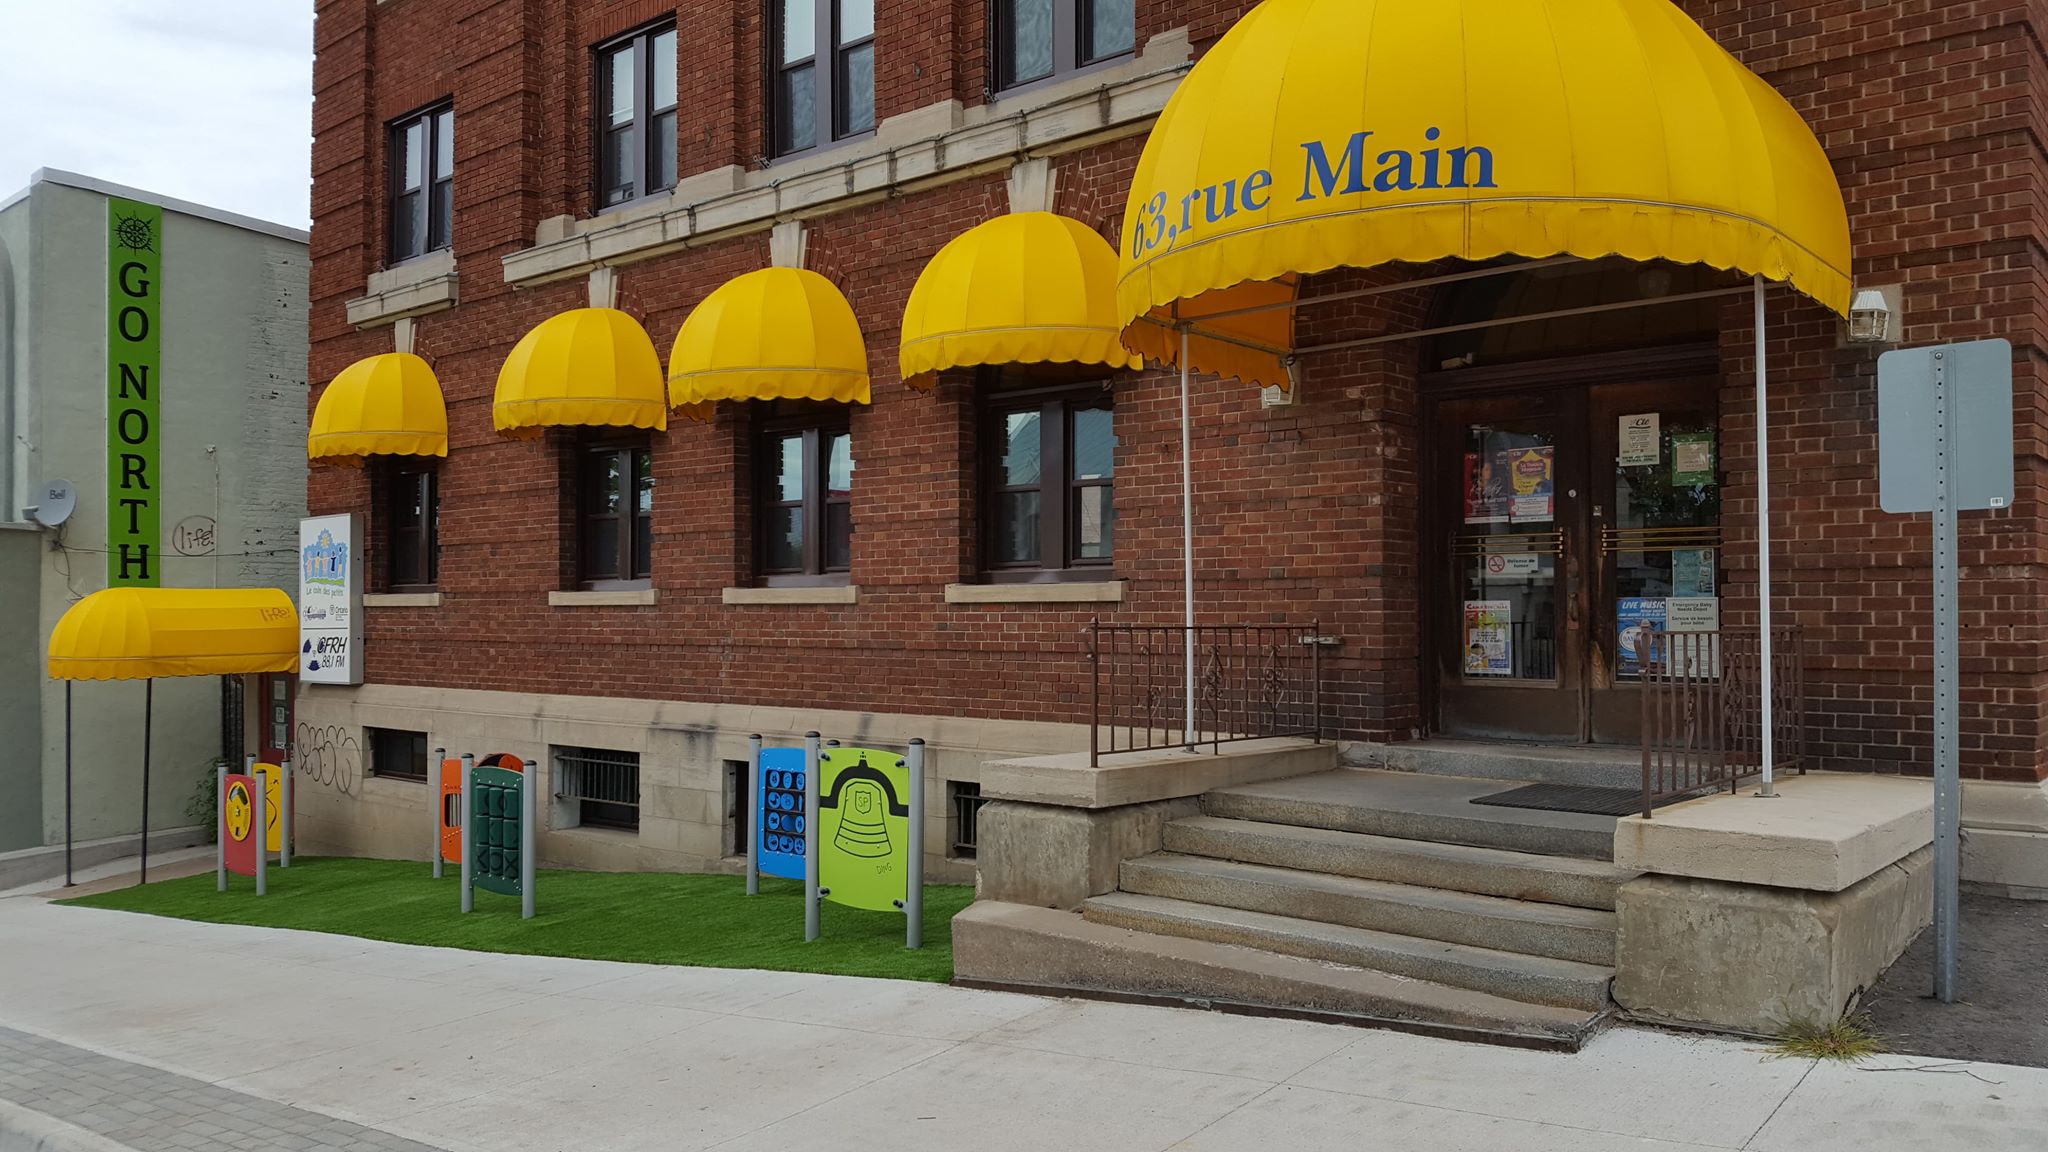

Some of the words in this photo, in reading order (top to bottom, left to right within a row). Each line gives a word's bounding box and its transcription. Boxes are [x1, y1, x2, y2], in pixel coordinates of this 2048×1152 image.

[1296, 127, 1499, 202] Main
[118, 261, 150, 342] GO
[118, 363, 150, 579] NORTH
[49, 489, 66, 500] Bell
[180, 525, 214, 550] life!
[306, 587, 312, 595] Le
[1622, 601, 1638, 609] LIVE
[1640, 600, 1665, 609] MUSIC
[335, 655, 345, 668] FM
[858, 797, 868, 808] SP
[876, 863, 892, 875] DING
